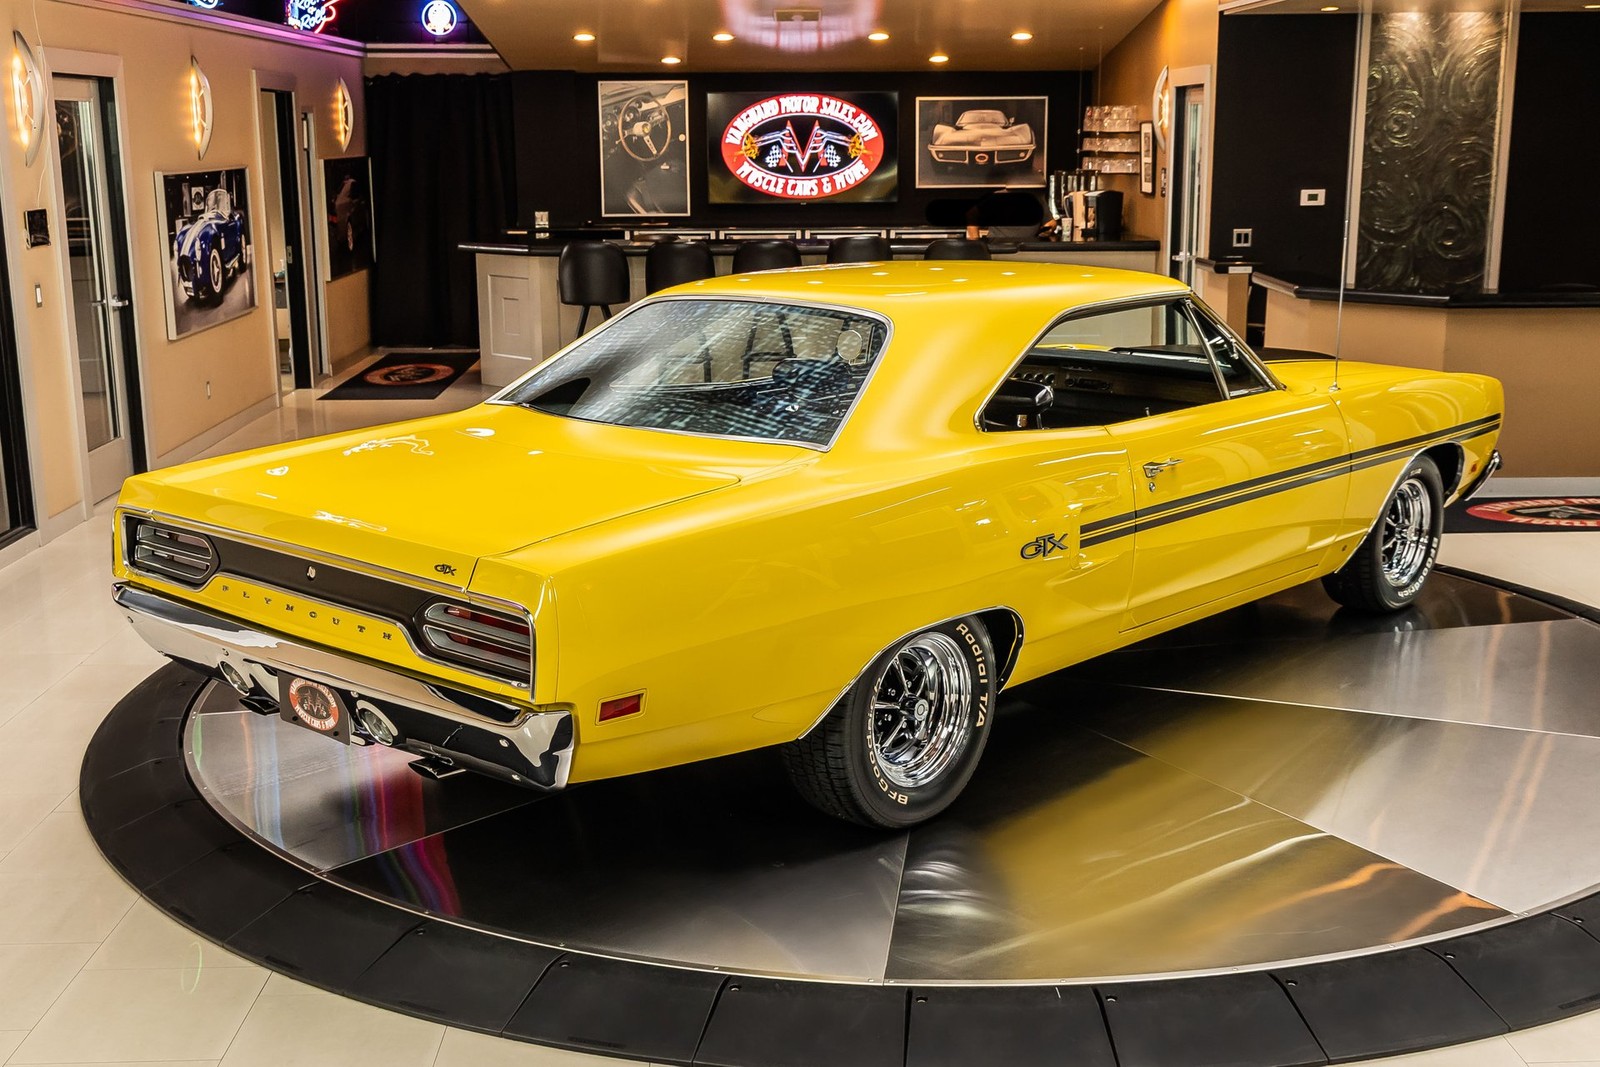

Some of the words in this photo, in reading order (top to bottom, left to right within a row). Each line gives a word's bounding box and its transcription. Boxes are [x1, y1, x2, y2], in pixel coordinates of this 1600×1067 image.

[725, 99, 779, 145] VANGUARD
[779, 96, 820, 113] MOTOR
[820, 97, 878, 141] SALES.COM
[736, 162, 786, 194] MUSCLE
[786, 179, 819, 196] CARS
[821, 177, 832, 194] &
[833, 160, 869, 190] MORE
[1020, 533, 1068, 559] GTX
[1398, 537, 1438, 598] BFGoodrich
[222, 584, 392, 641] PLYMOUTH
[955, 623, 988, 684] Radial
[975, 693, 988, 727] T/A
